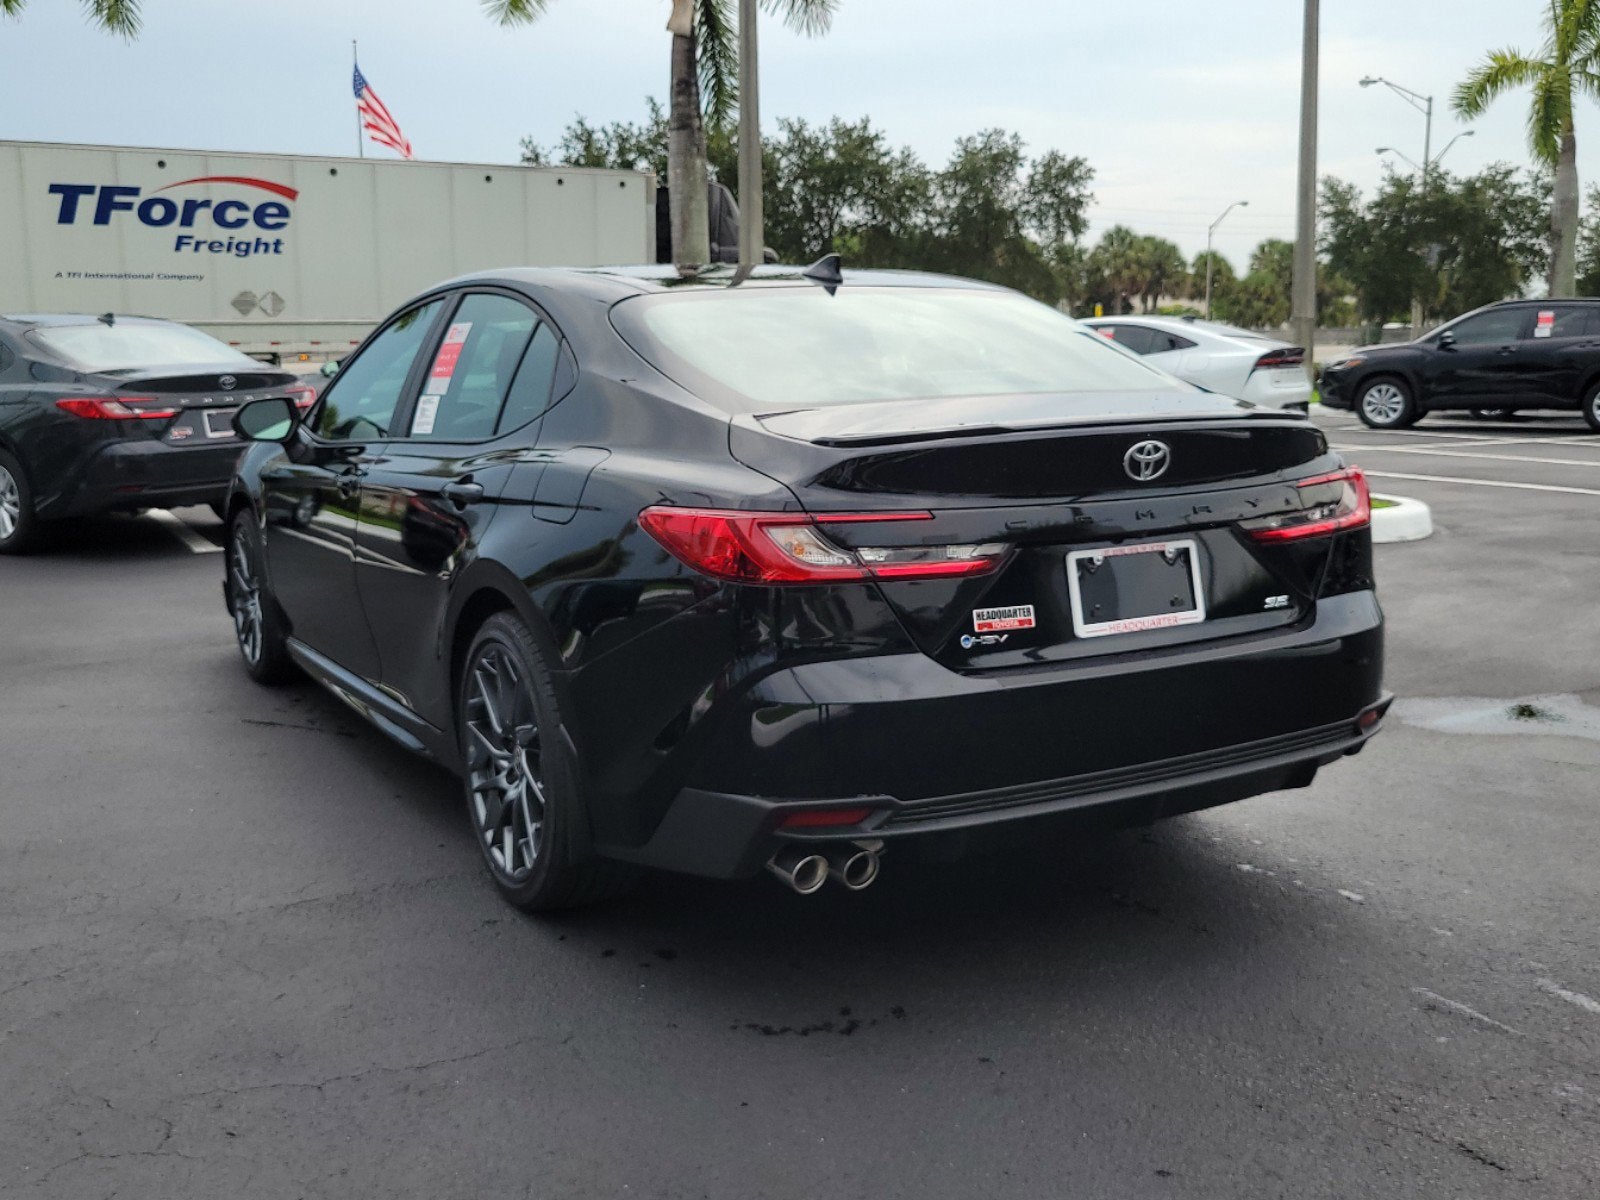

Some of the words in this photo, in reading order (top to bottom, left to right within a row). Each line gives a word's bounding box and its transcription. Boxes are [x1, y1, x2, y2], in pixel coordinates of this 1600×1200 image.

[48, 184, 291, 230] TForce
[174, 235, 284, 257] Freight
[85, 272, 155, 280] International
[157, 273, 205, 281] Company
[975, 606, 1032, 620] HEADQUARTER
[1108, 616, 1178, 632] HEADQUARTER
